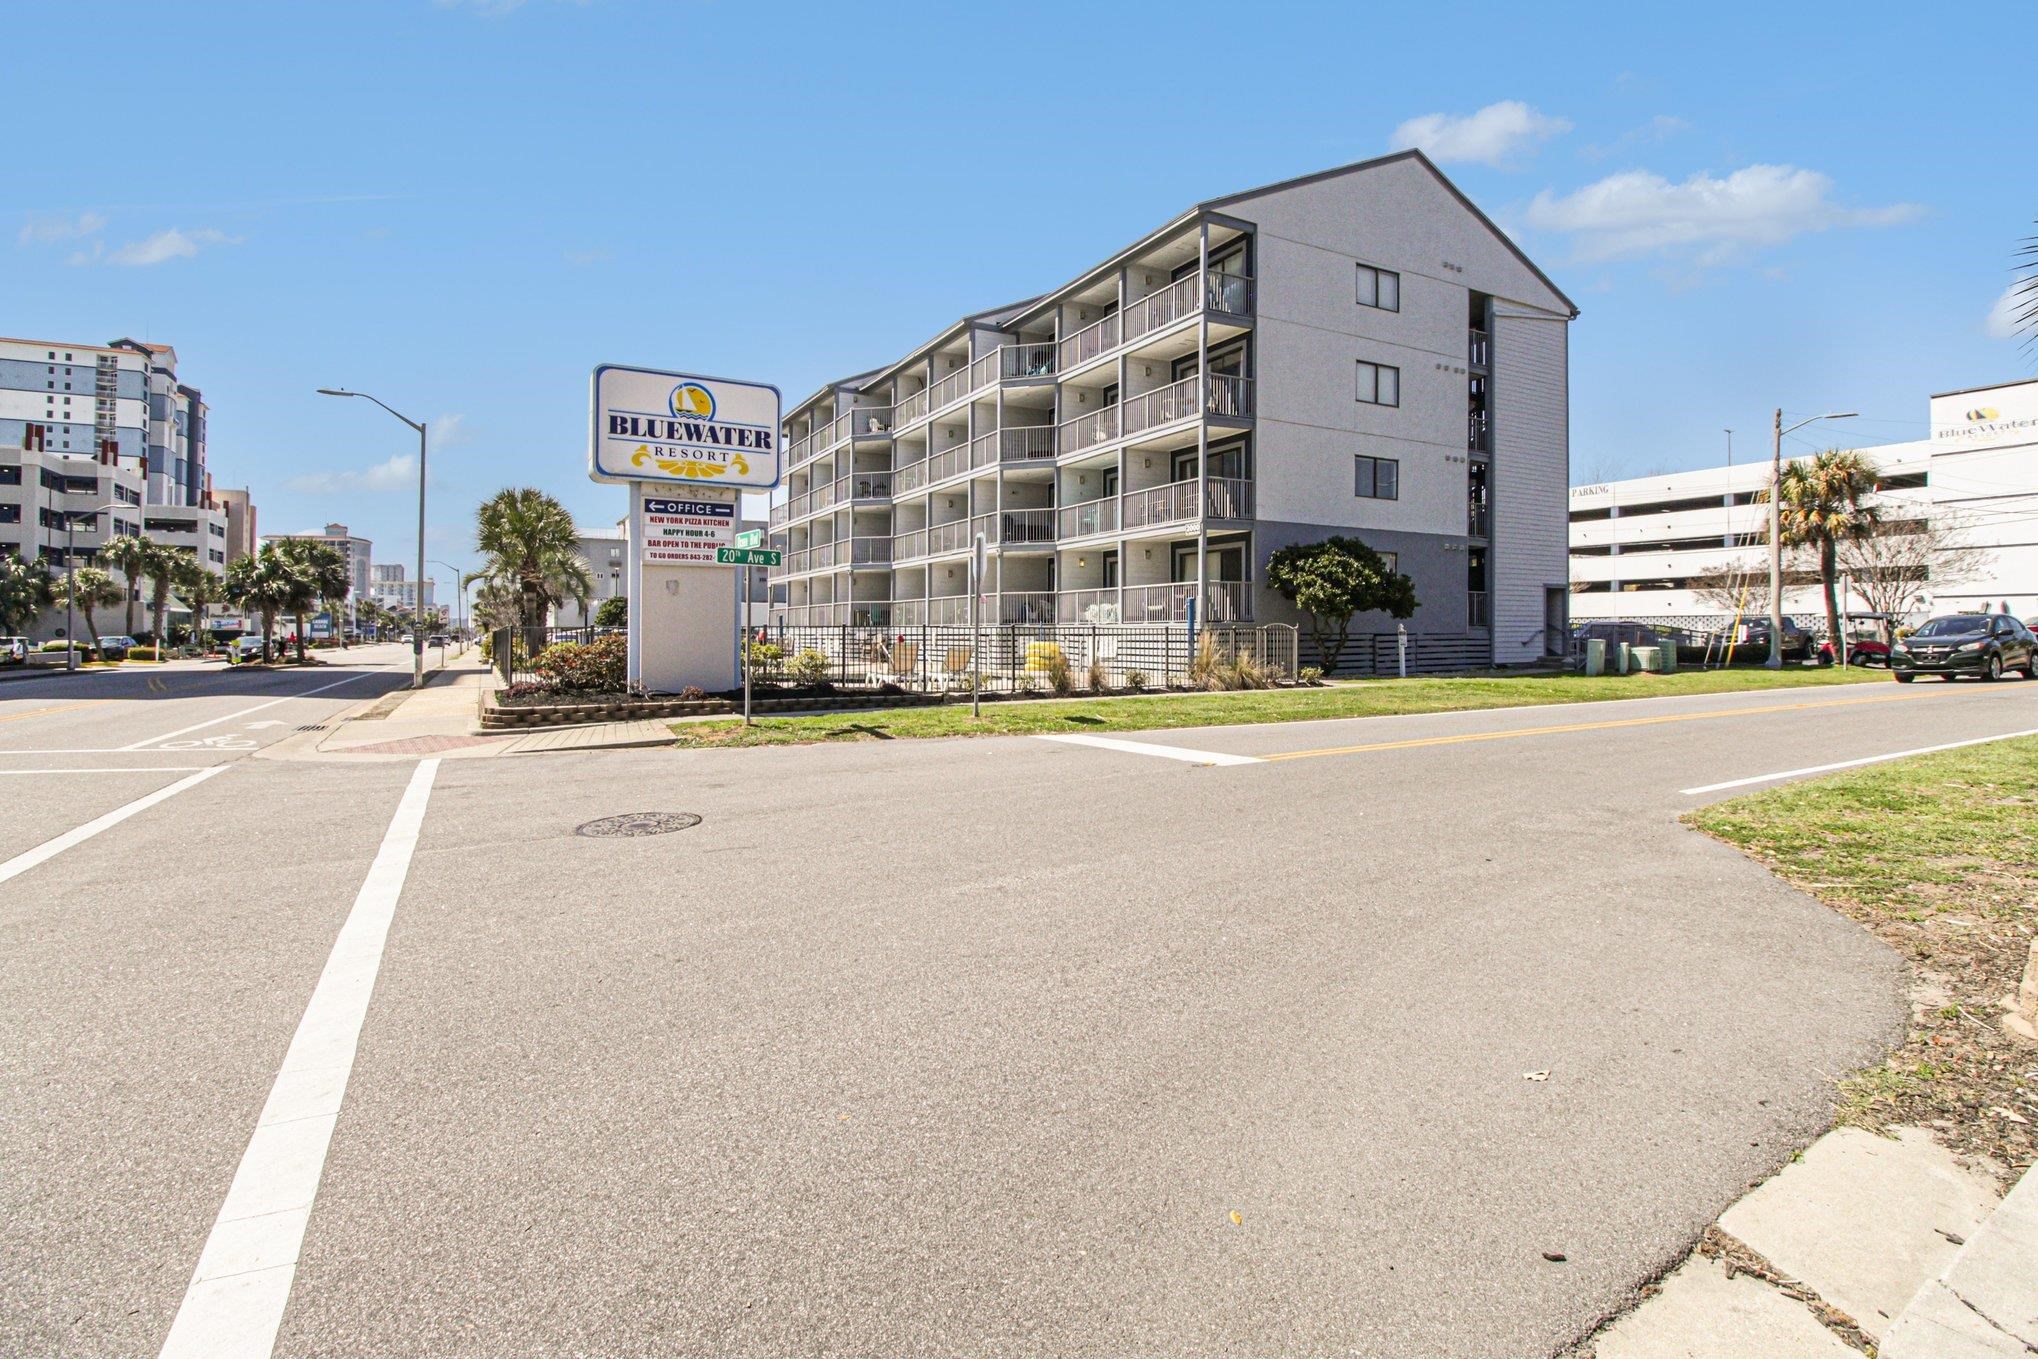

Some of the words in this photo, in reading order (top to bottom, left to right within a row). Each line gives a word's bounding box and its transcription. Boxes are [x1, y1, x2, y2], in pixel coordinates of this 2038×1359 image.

[608, 415, 772, 449] BLUEWATER
[655, 446, 729, 462] RESORT
[1571, 485, 1609, 497] PARKING
[667, 503, 712, 514] OFFICE
[667, 516, 683, 524] YORK
[685, 517, 702, 525] PIZZA
[703, 518, 730, 527] KITCHEN
[685, 529, 703, 537] HOUR
[704, 530, 716, 538] 4-6
[662, 540, 679, 548] OPEN
[690, 541, 702, 549] THE
[747, 551, 764, 564] Ave
[770, 552, 777, 565] S
